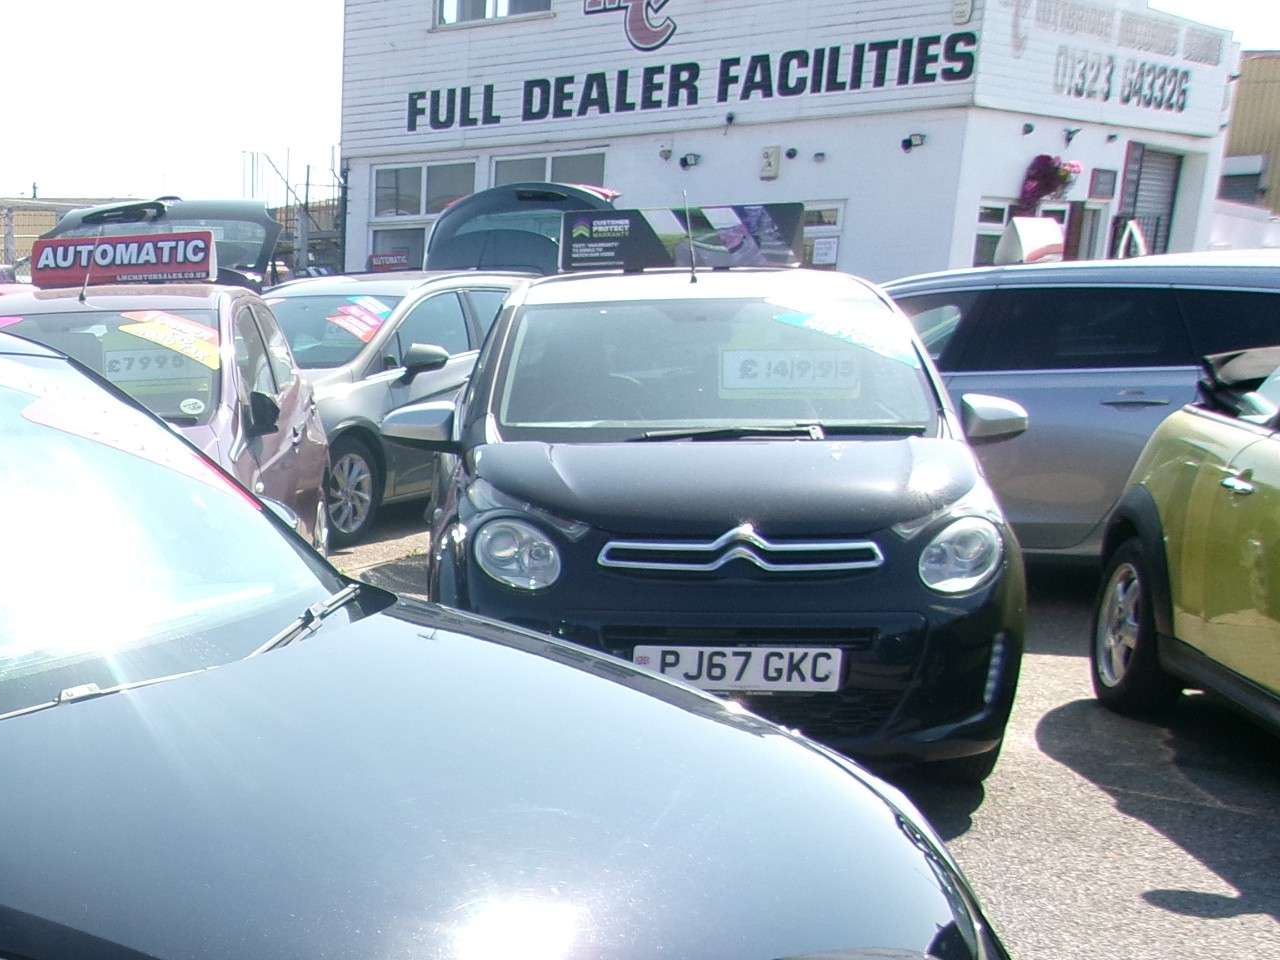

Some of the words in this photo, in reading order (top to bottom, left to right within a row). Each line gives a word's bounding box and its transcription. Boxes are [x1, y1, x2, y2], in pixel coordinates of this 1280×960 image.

[406, 84, 501, 132] FULL
[521, 61, 701, 122] DEALER
[716, 30, 978, 103] FACILITIES
[36, 238, 207, 269] AUTOMATIC
[659, 649, 753, 682] PJ67
[762, 651, 833, 683] GKC
